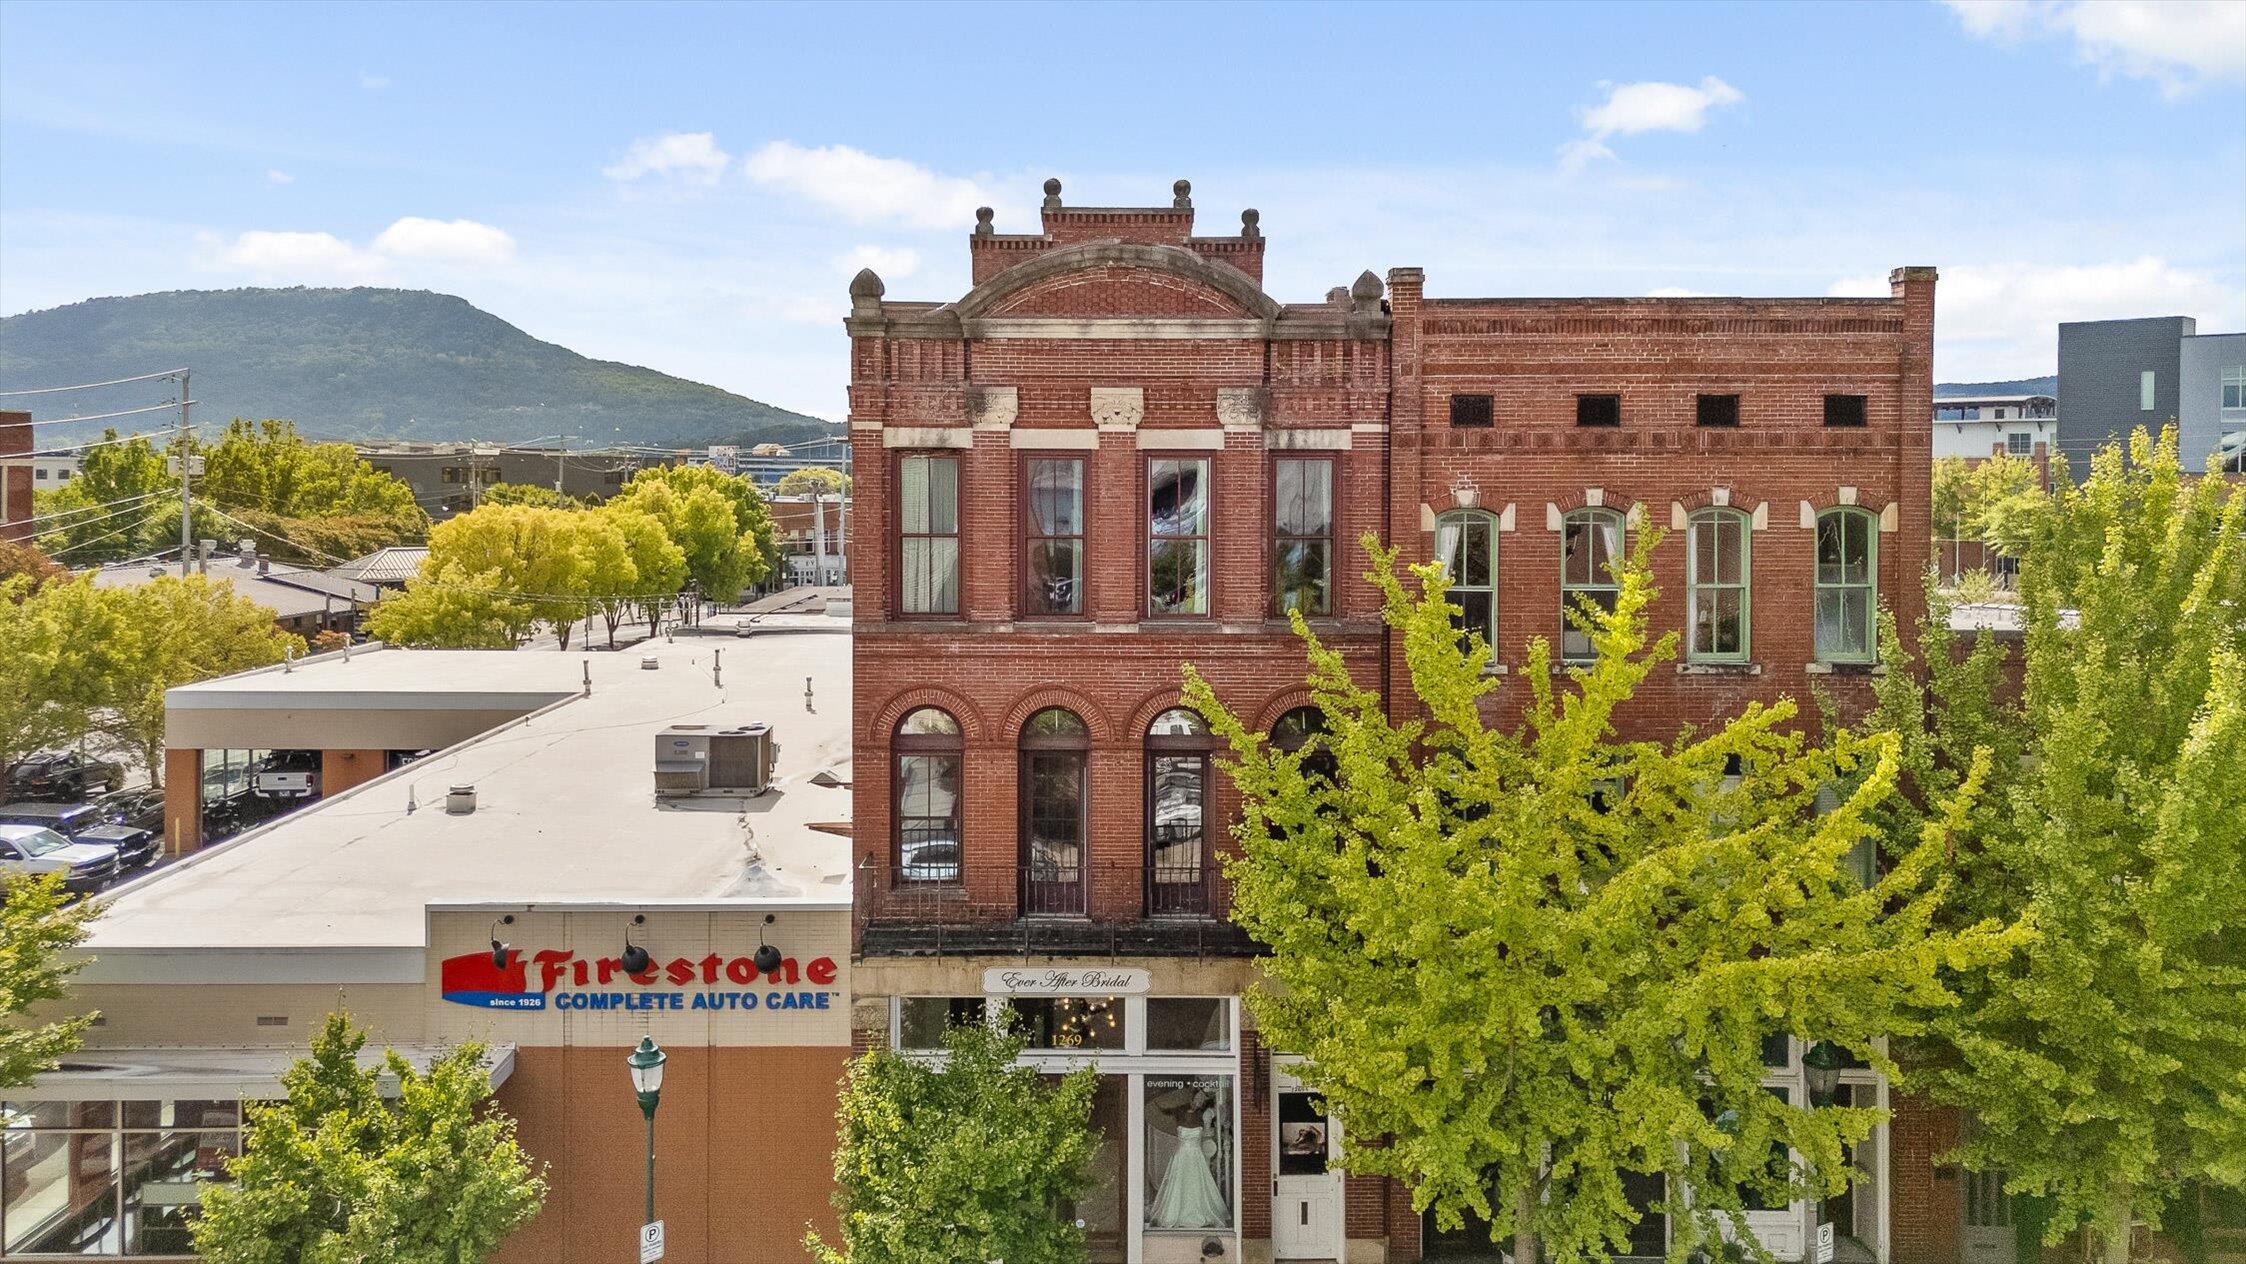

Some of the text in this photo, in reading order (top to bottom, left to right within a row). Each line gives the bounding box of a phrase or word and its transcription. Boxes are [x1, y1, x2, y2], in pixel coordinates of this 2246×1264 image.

[534, 950, 838, 993] Firestone
[1001, 970, 1132, 991] Ever After Bridal
[490, 998, 541, 1007] since 1926
[555, 992, 684, 1010] COMPLETE
[691, 992, 758, 1010] AUTO
[1051, 1034, 1082, 1046] 1269
[1147, 1080, 1184, 1090] evening
